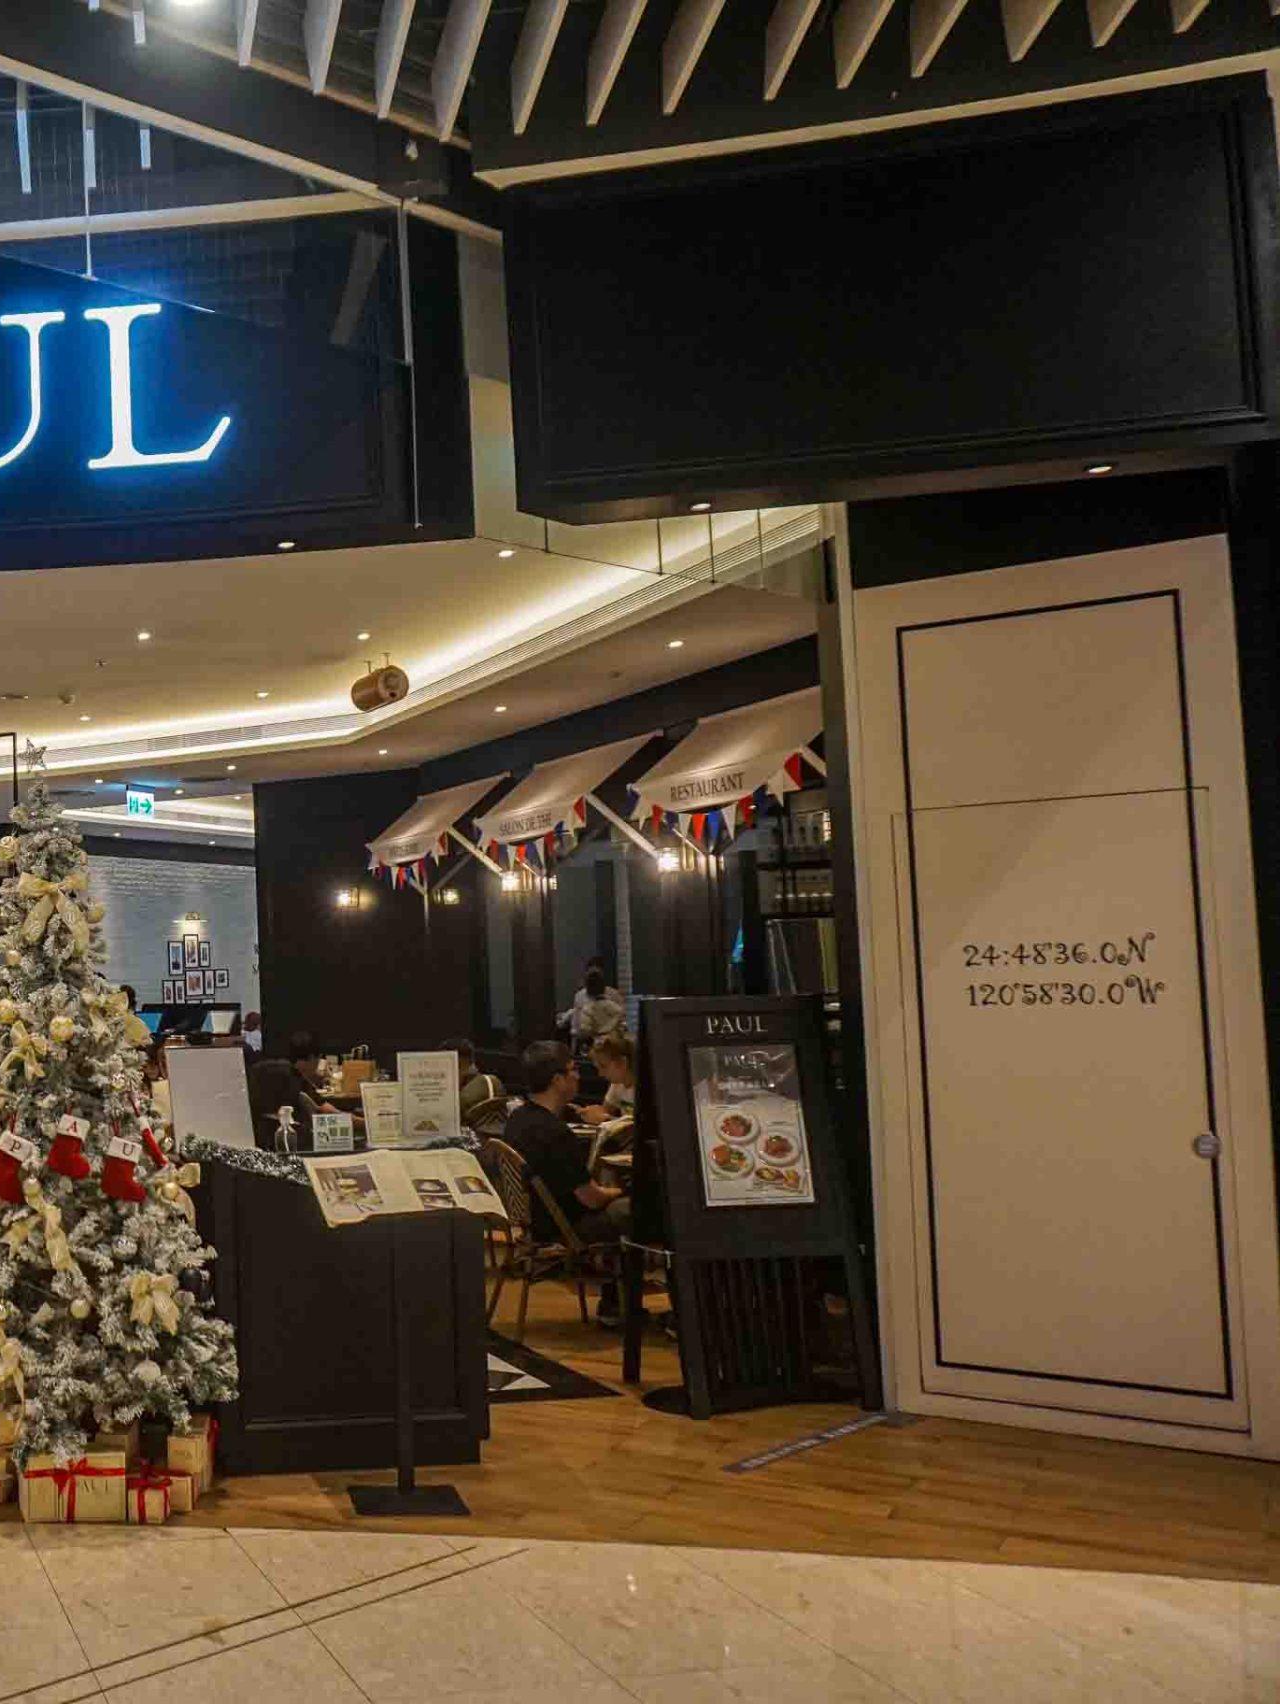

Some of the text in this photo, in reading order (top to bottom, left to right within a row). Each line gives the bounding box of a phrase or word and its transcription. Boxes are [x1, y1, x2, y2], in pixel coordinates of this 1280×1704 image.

[670, 771, 746, 802] RESTAURANT
[706, 1015, 769, 1035] PAUL
[11, 1140, 22, 1152] P
[122, 1142, 135, 1156] U
